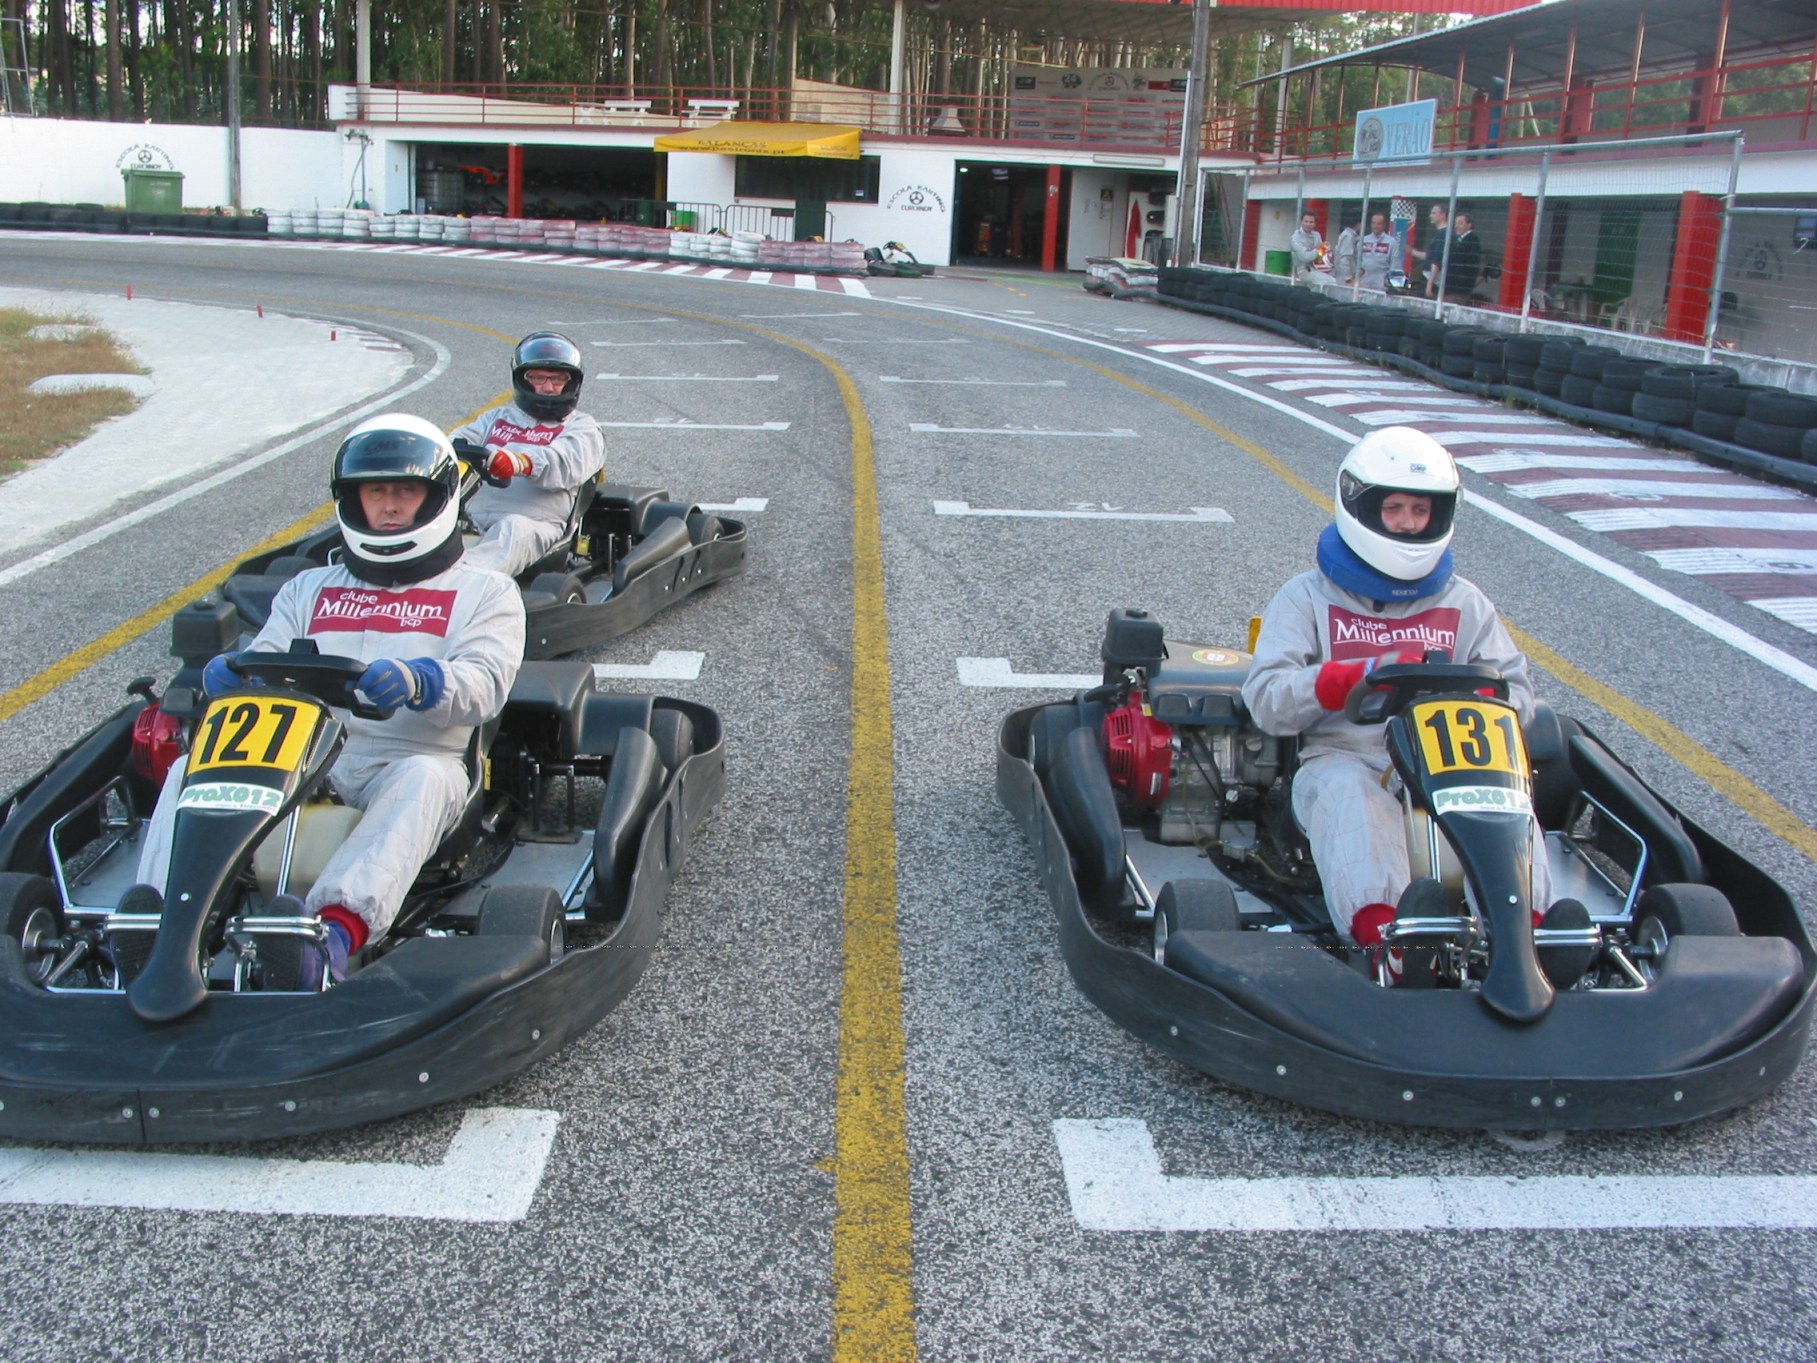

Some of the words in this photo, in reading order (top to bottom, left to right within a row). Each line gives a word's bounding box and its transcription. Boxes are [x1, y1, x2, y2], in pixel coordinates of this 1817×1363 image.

[144, 143, 175, 170] KARTING
[887, 185, 912, 209] ESCOLA
[917, 185, 946, 212] KARTING
[318, 597, 442, 618] Millennium
[340, 590, 378, 604] clube
[400, 617, 422, 627] bcp
[1334, 618, 1455, 646] Millennium
[1351, 618, 1388, 630] clube
[199, 703, 297, 765] 127
[1425, 708, 1516, 770] 131
